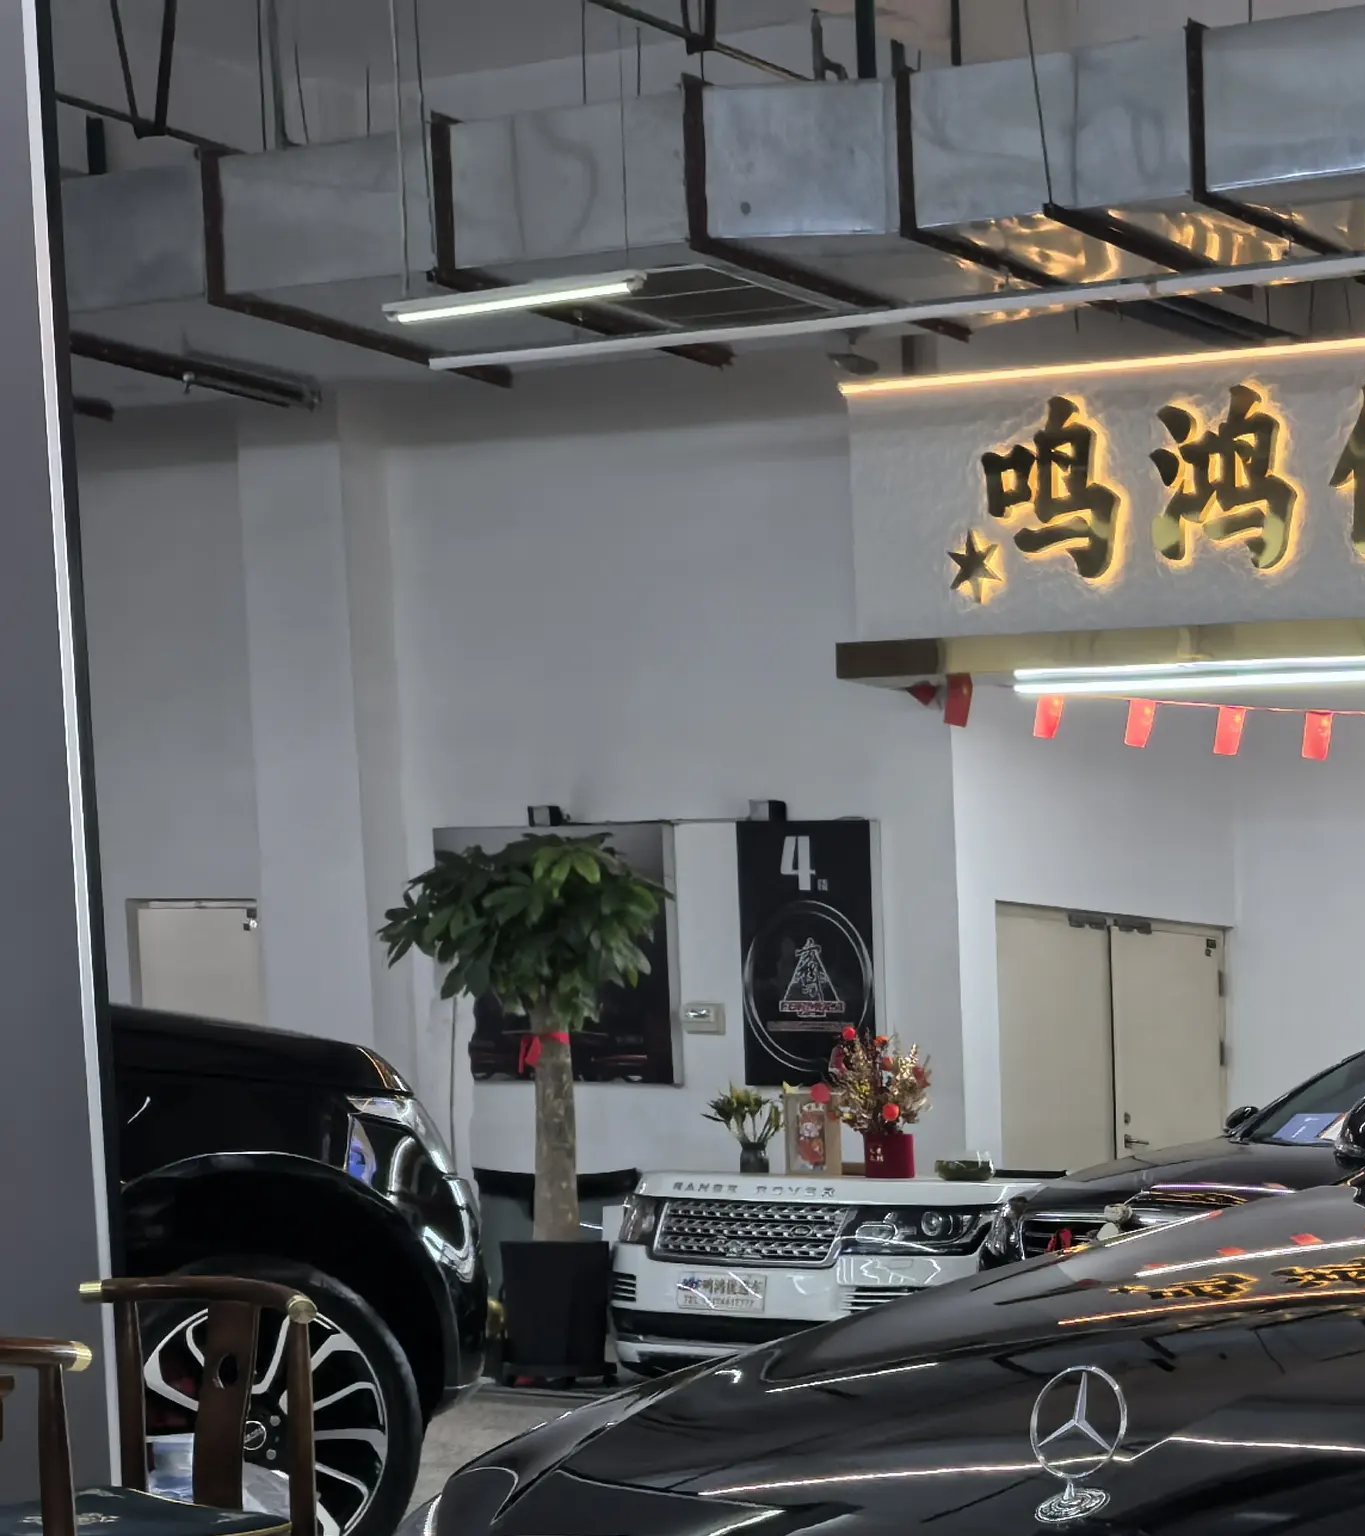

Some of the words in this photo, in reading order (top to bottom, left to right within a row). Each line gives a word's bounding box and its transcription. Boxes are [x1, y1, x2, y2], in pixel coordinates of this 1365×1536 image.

[780, 835, 816, 891] 4
[673, 1181, 738, 1194] RANGE
[755, 1185, 835, 1198] ROVER
